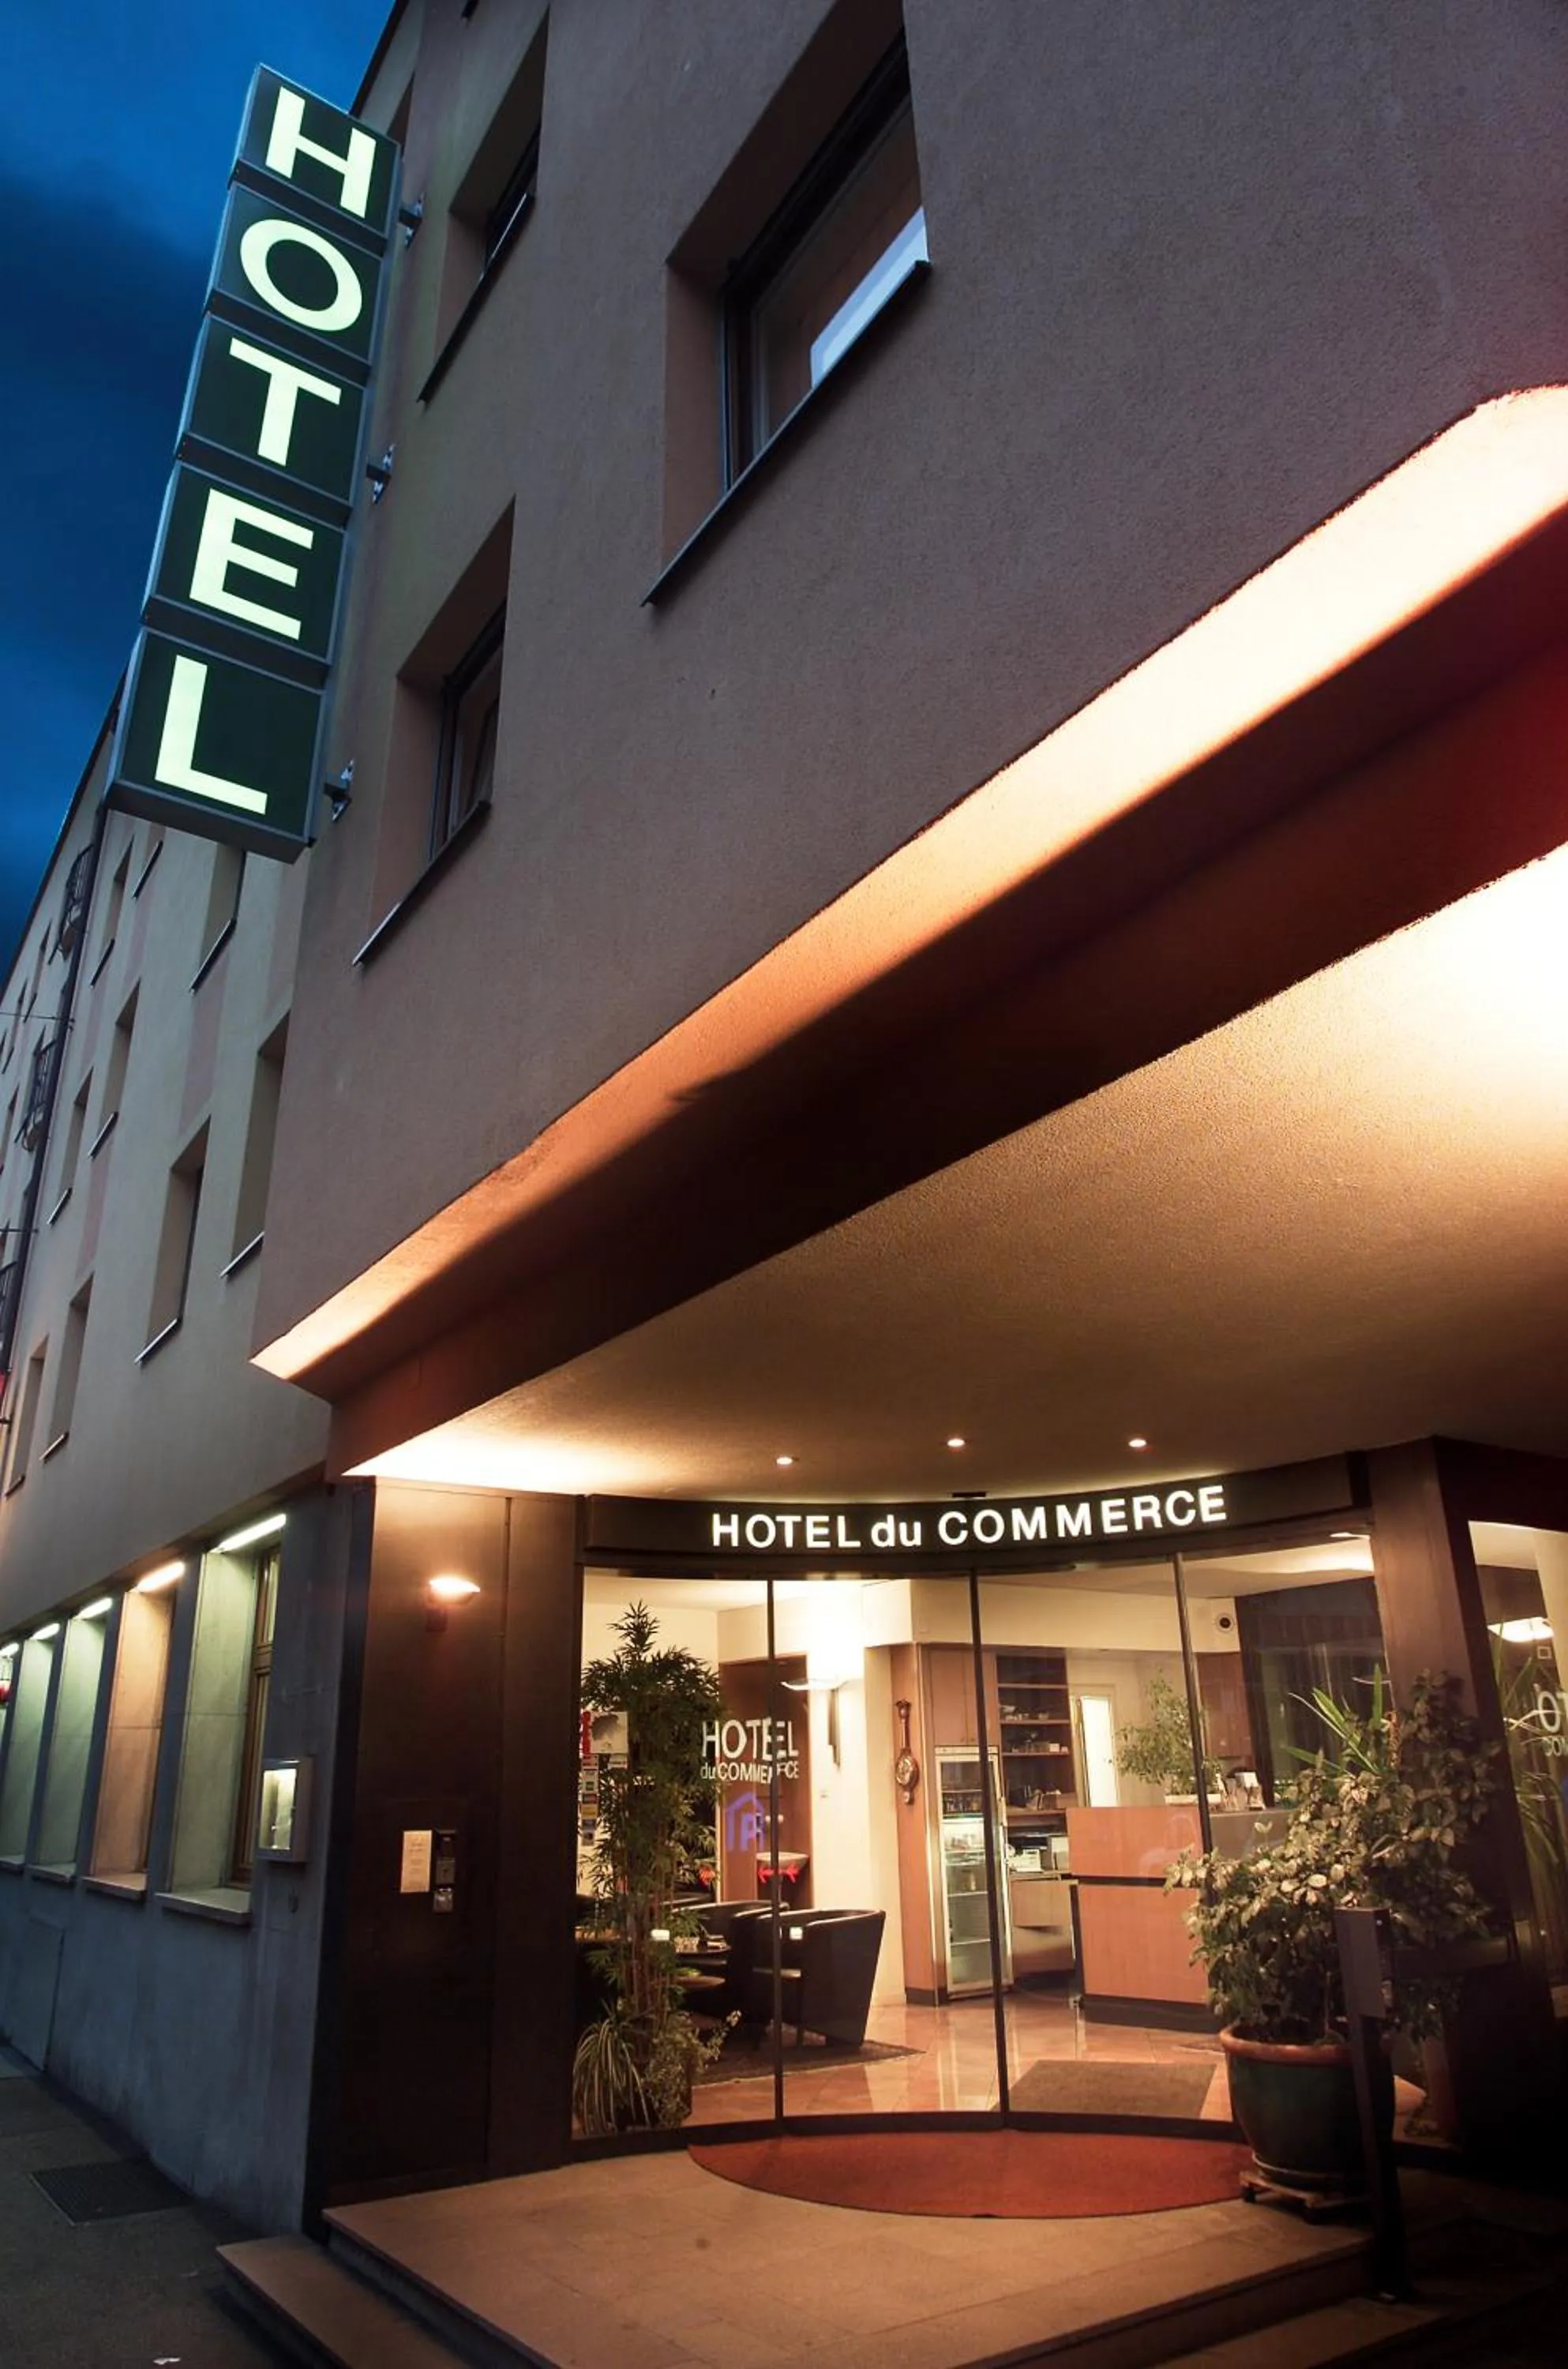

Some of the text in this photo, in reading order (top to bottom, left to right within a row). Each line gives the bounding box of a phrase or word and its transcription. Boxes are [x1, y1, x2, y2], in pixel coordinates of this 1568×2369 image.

[154, 85, 377, 815] HOTEL
[711, 1485, 1227, 1549] HOTEL du COMMERCE
[702, 1718, 799, 1761] HOTEL
[700, 1762, 717, 1779] du
